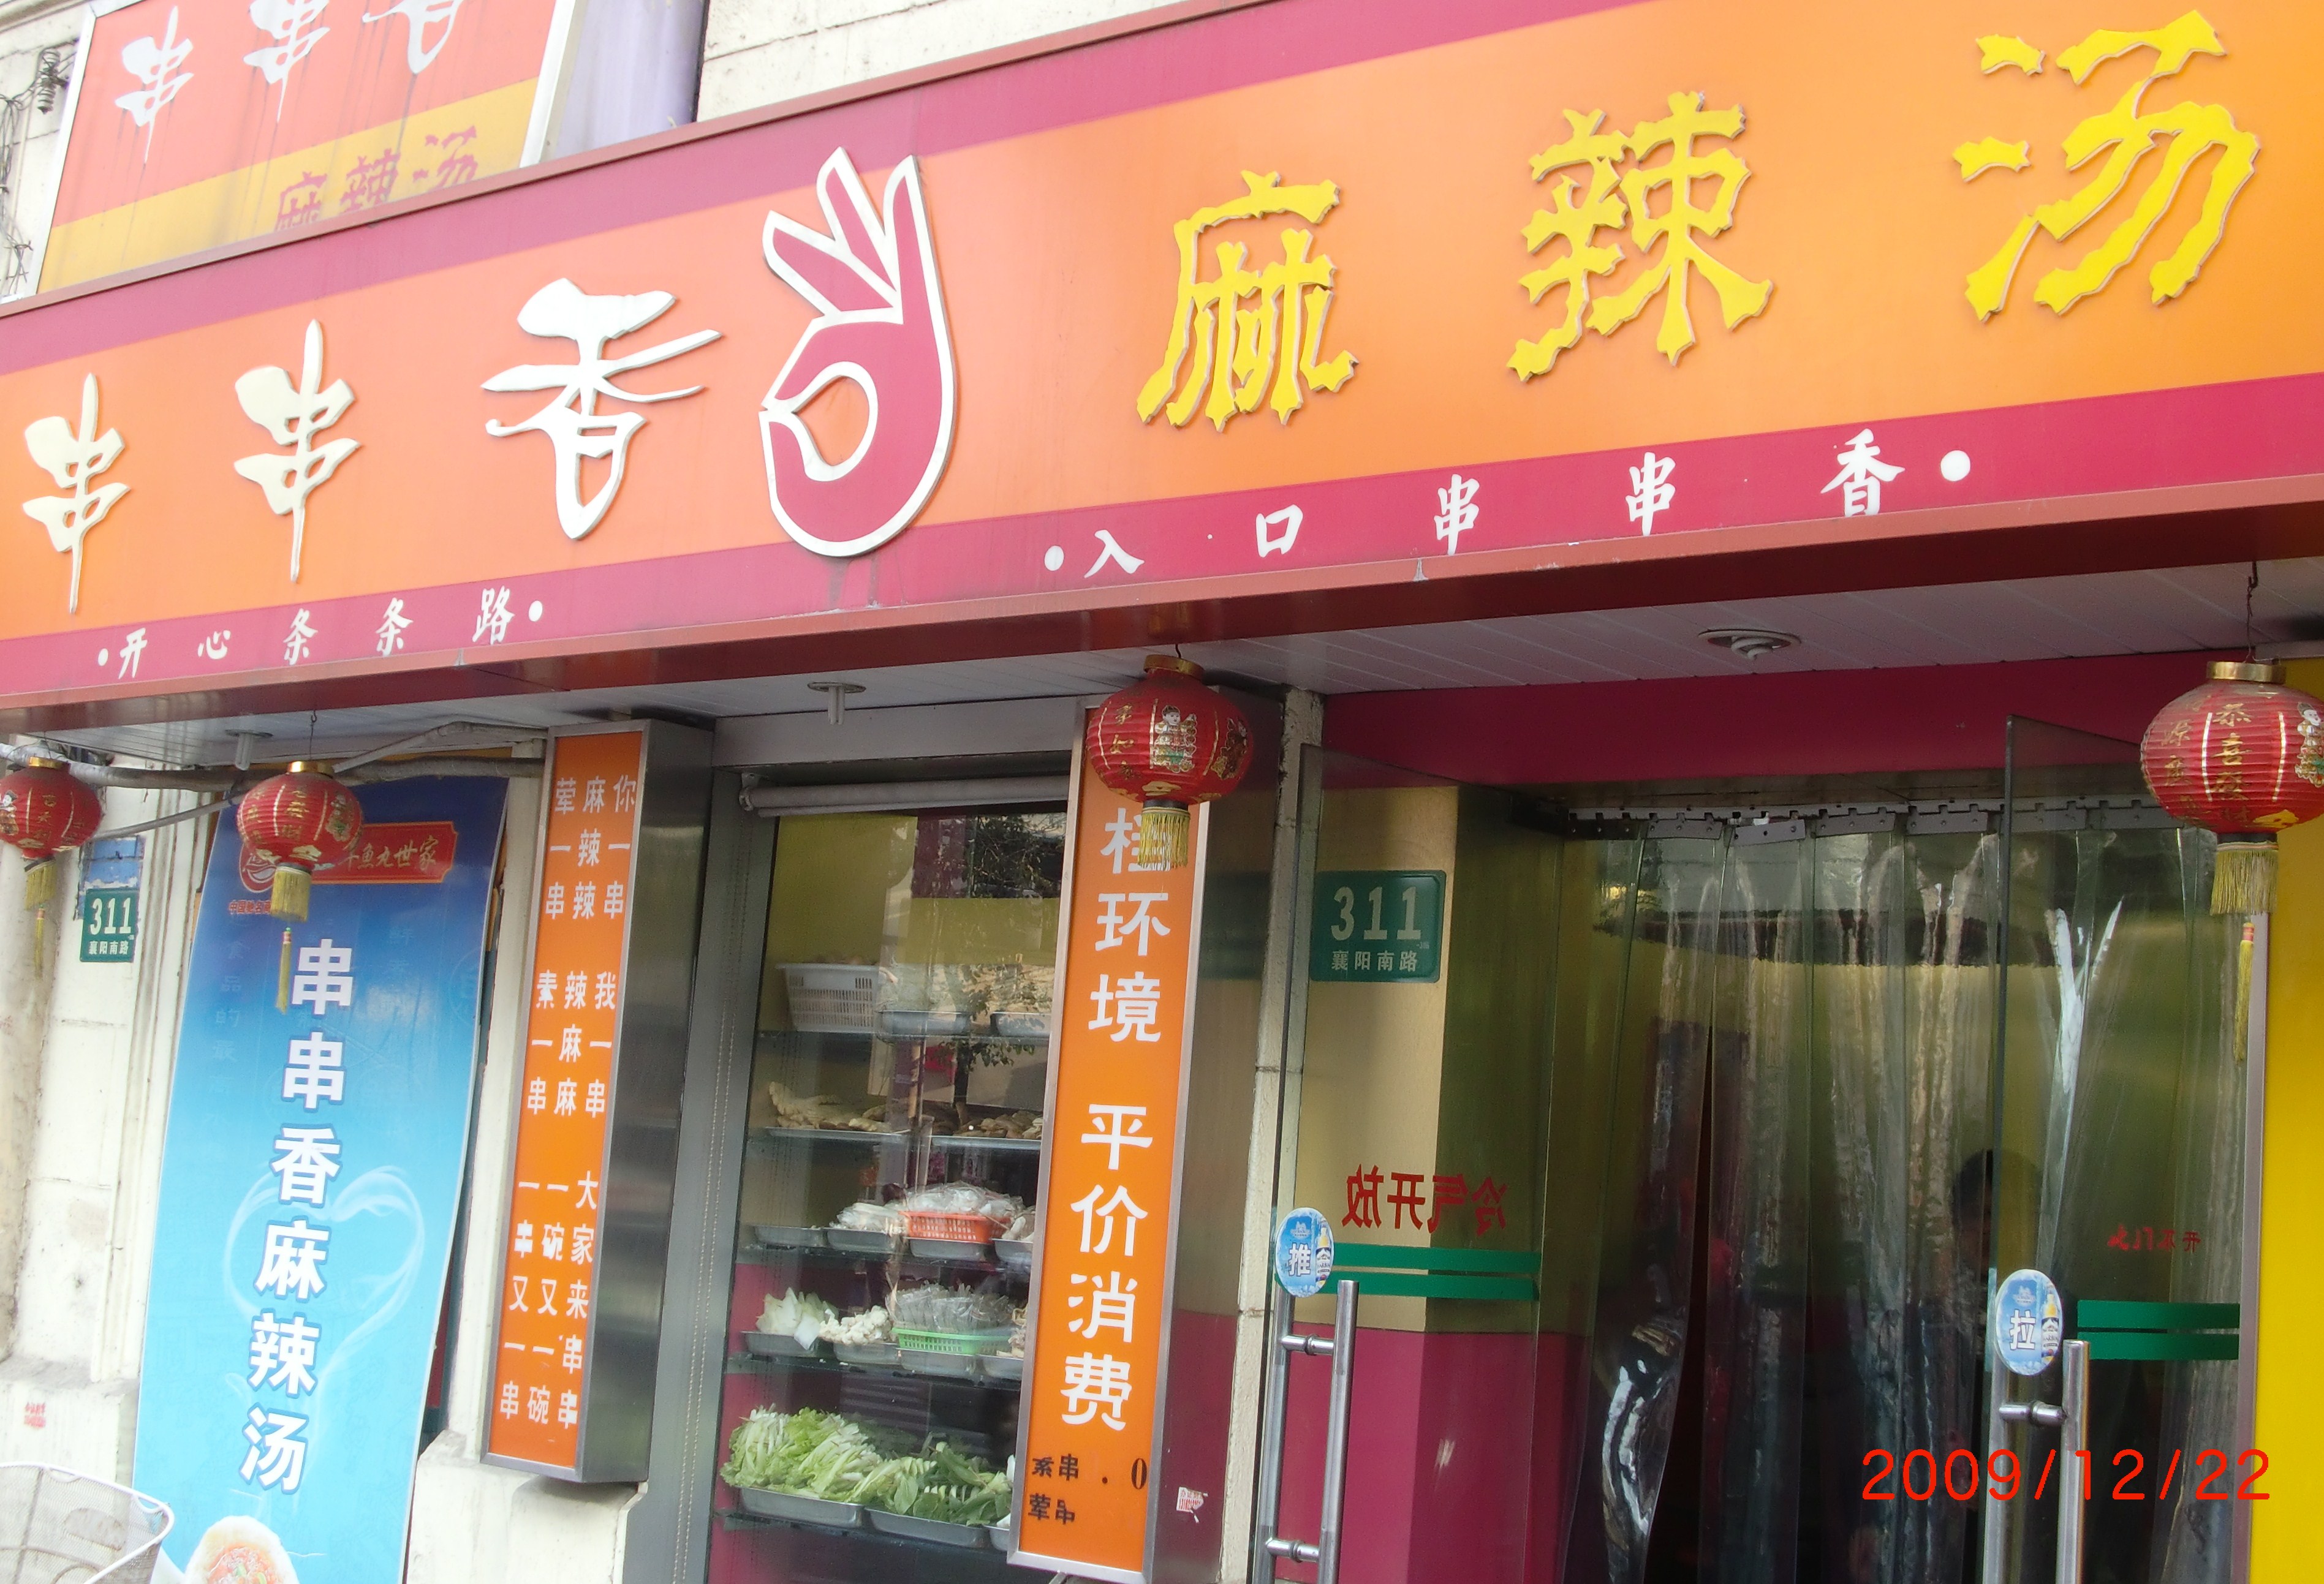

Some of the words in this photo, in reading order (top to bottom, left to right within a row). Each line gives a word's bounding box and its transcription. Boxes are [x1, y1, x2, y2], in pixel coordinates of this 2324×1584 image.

[23, 277, 723, 614] 串串香
[1136, 9, 2261, 432] 麻辣汤
[1083, 428, 1905, 578] 入口串串香
[119, 586, 516, 679] 开心条条路
[89, 897, 131, 935] 311
[1331, 886, 1421, 941] 311
[89, 941, 129, 955] 襄阳南路
[1331, 950, 1417, 971] 襄阳南路
[241, 938, 354, 1490] 串串香麻辣汤
[1060, 1104, 1153, 1431] 平价消费
[1288, 1242, 1312, 1277] 推
[2010, 1308, 2036, 1351] 拉
